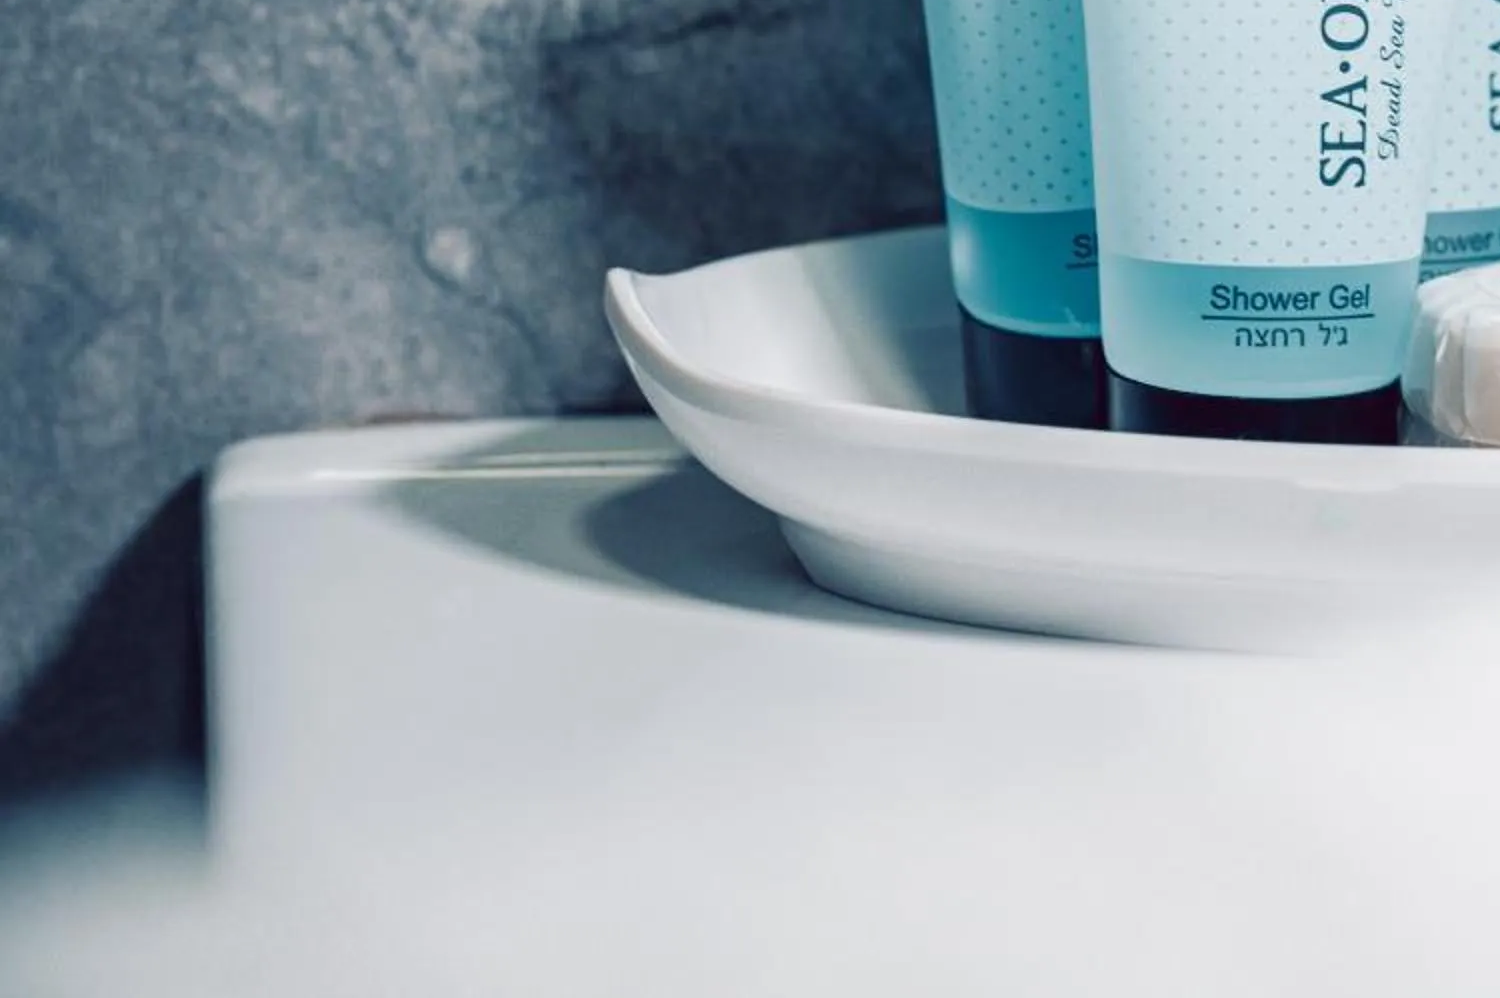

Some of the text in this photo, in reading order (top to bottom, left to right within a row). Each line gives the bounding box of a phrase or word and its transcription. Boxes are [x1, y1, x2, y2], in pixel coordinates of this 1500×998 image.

[1379, 14, 1405, 73] Sea
[1378, 78, 1402, 160] Dead
[1210, 283, 1371, 312] Shower Gel
[1235, 326, 1305, 347] רחצה
